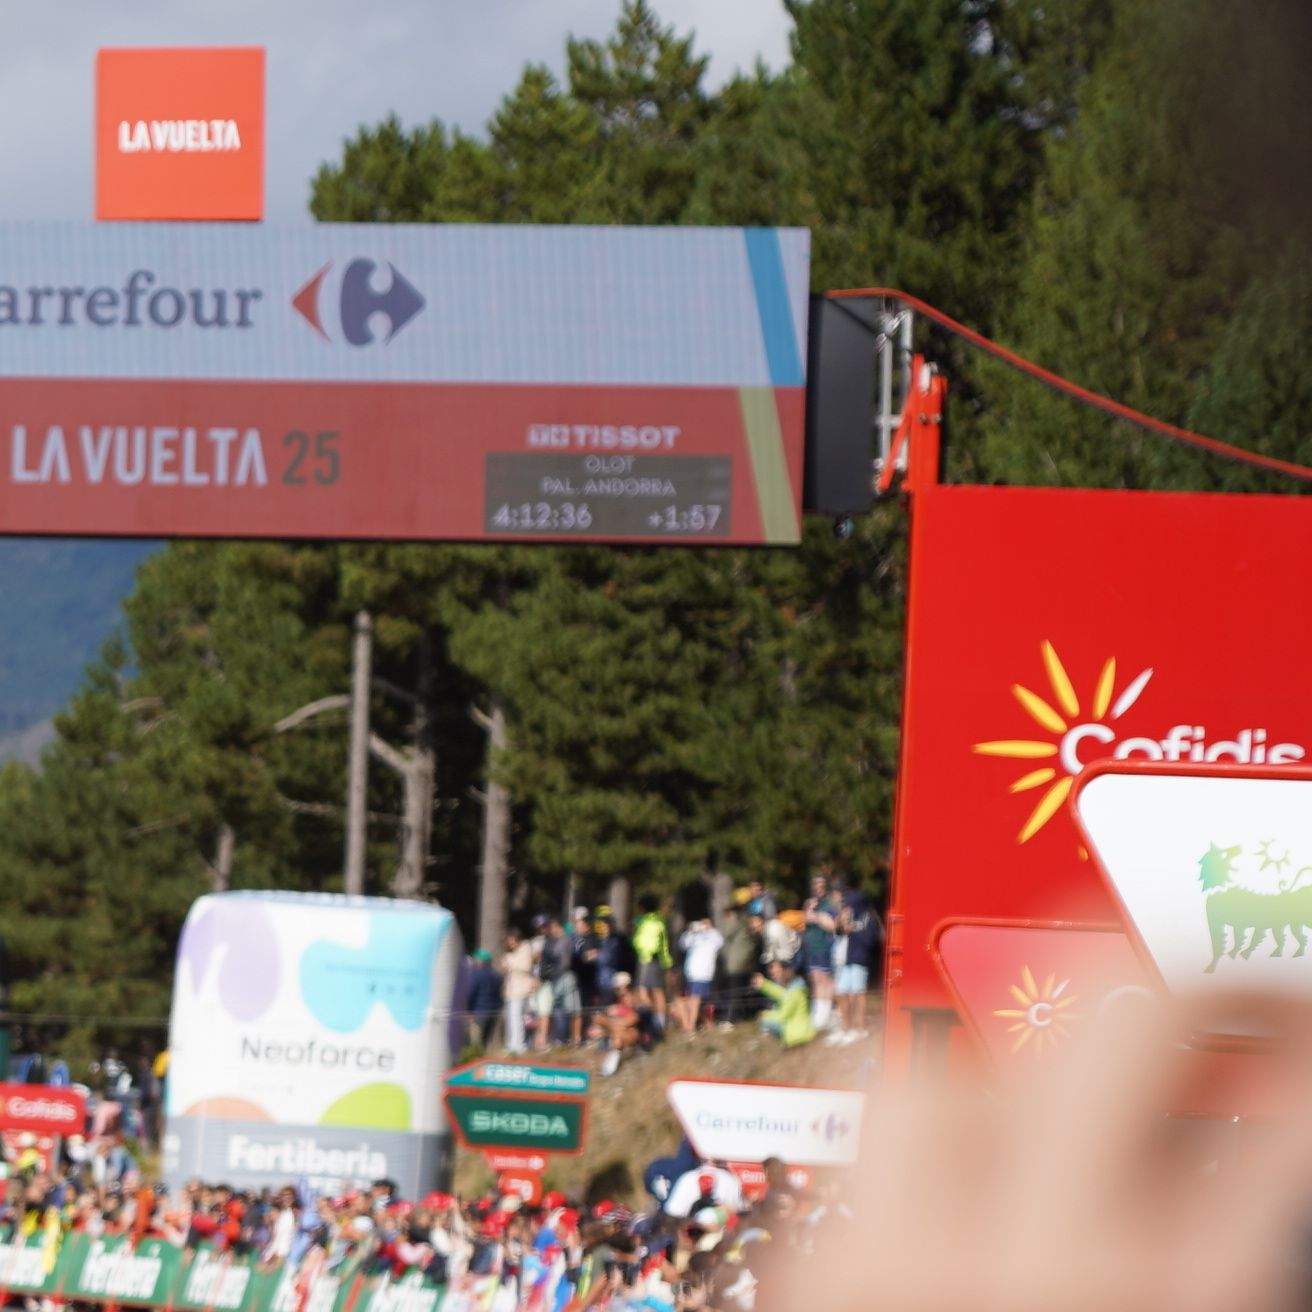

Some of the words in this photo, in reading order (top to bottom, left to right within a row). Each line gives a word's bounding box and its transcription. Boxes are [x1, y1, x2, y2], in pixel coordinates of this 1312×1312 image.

[118, 120, 151, 153] LA
[151, 119, 241, 152] VUELTA
[574, 425, 682, 448] TISSOT
[12, 426, 70, 484] LA
[81, 427, 268, 487] VUELTA
[282, 431, 341, 487] 25
[585, 455, 636, 474] OLOT
[584, 478, 677, 497] ANDORRA
[493, 503, 593, 530] 4:12:36
[647, 504, 722, 531] +1:57
[242, 1036, 395, 1072] Neoforce
[228, 1134, 387, 1175] Fertiberia
